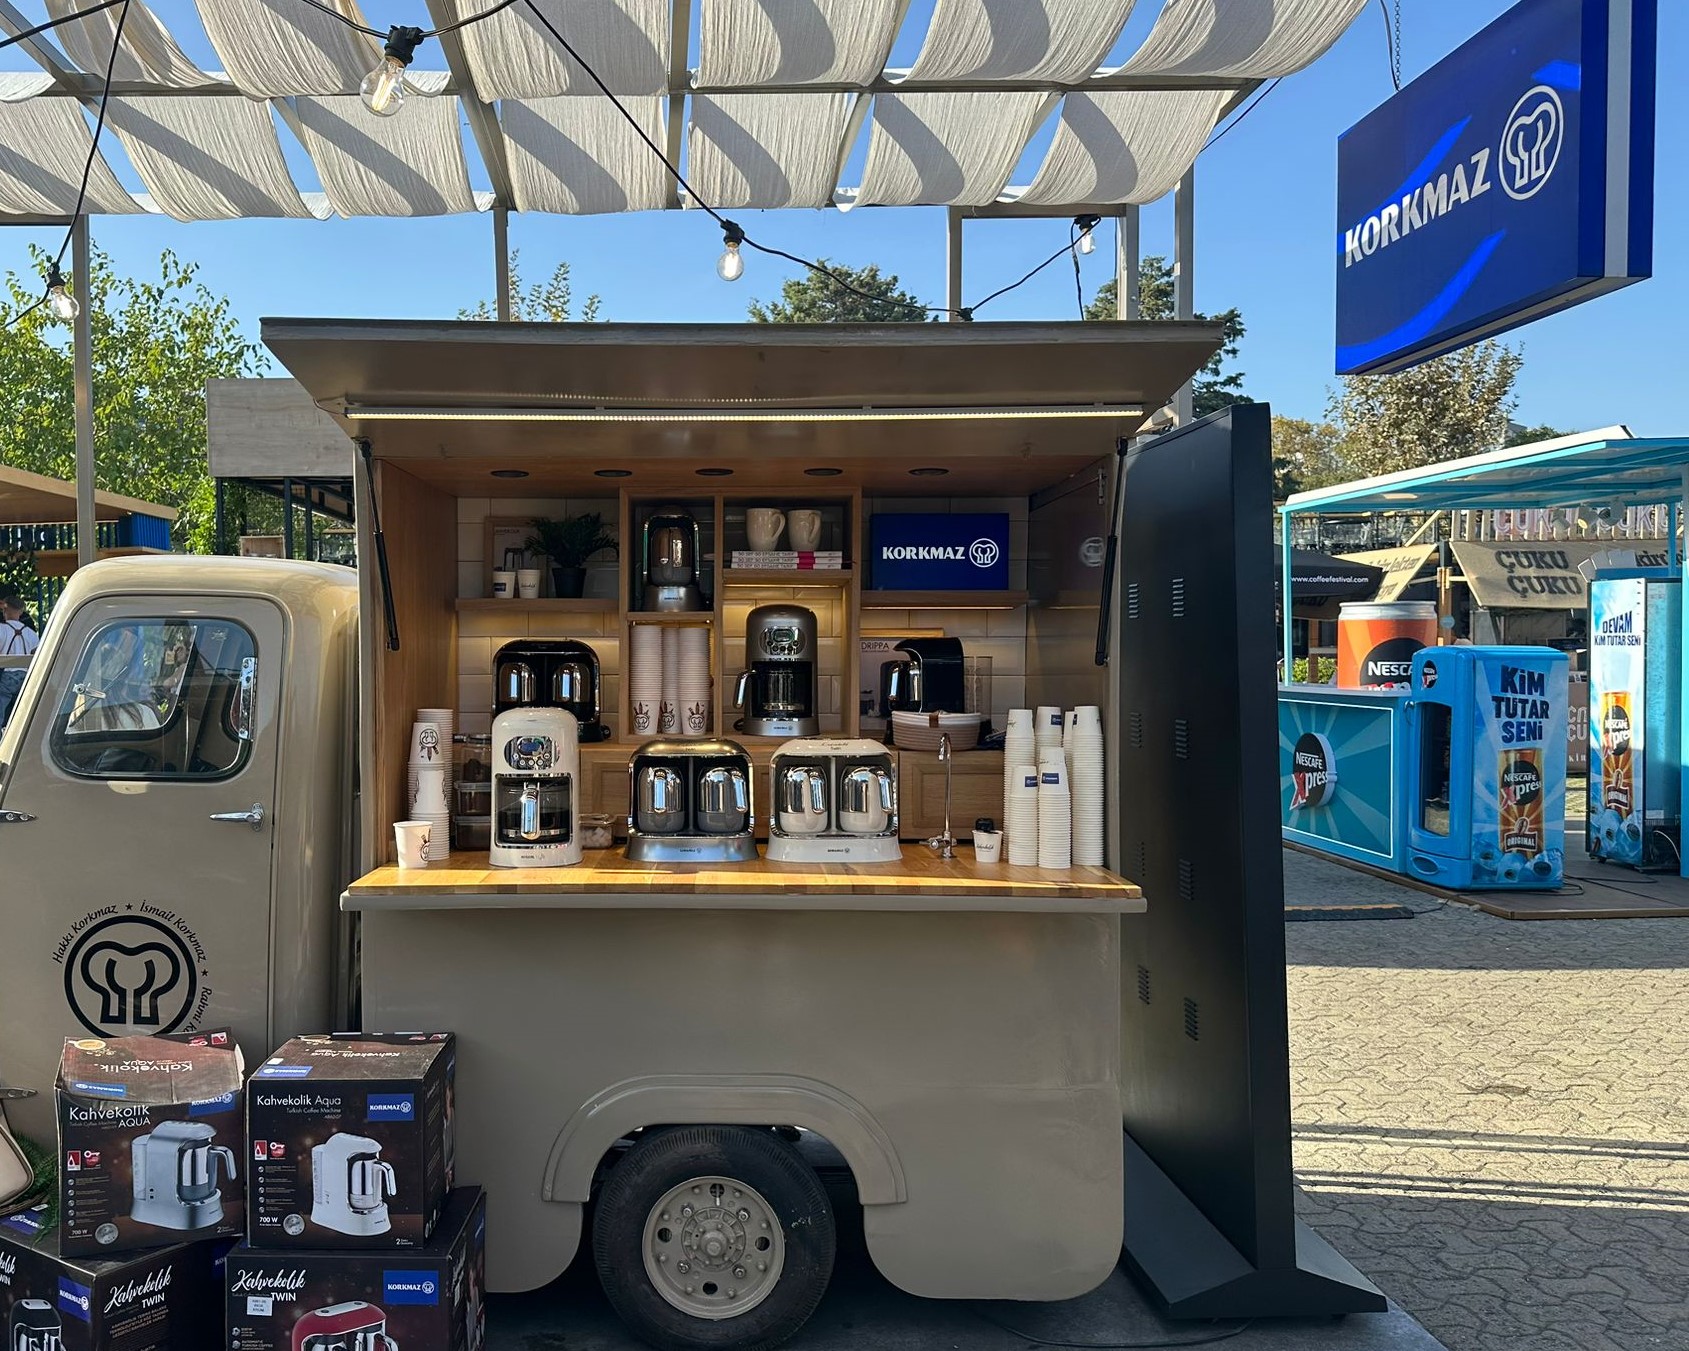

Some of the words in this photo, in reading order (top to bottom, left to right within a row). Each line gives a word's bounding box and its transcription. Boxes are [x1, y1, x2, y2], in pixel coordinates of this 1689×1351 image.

[1345, 147, 1490, 268] KORKMAZ
[882, 546, 966, 560] KORKMAZ
[1495, 550, 1570, 573] ÇUKU
[1291, 575, 1369, 584] www.coffeefestival.com
[1507, 575, 1583, 598] ÇUKU
[1602, 610, 1632, 634] DEVAM
[861, 641, 890, 650] DRIPPA
[1492, 695, 1549, 720] TUTAR
[52, 931, 74, 964] Hakkı
[71, 904, 118, 934] Korkmaz
[139, 899, 176, 922] İsmail
[173, 918, 206, 963] Korkmaz
[193, 987, 212, 1024] Rahmi
[100, 1063, 193, 1073] Kahvekolik
[257, 1094, 312, 1106] Kahvekolik
[314, 1095, 342, 1108] Aqua
[69, 1104, 150, 1121] Kahvekolik
[118, 1116, 151, 1129] AQUA
[104, 1264, 172, 1313] Kahvekolik
[230, 1269, 306, 1292] Kahvekolik
[142, 1292, 165, 1308] TWIN
[270, 1292, 297, 1301] TWIN
